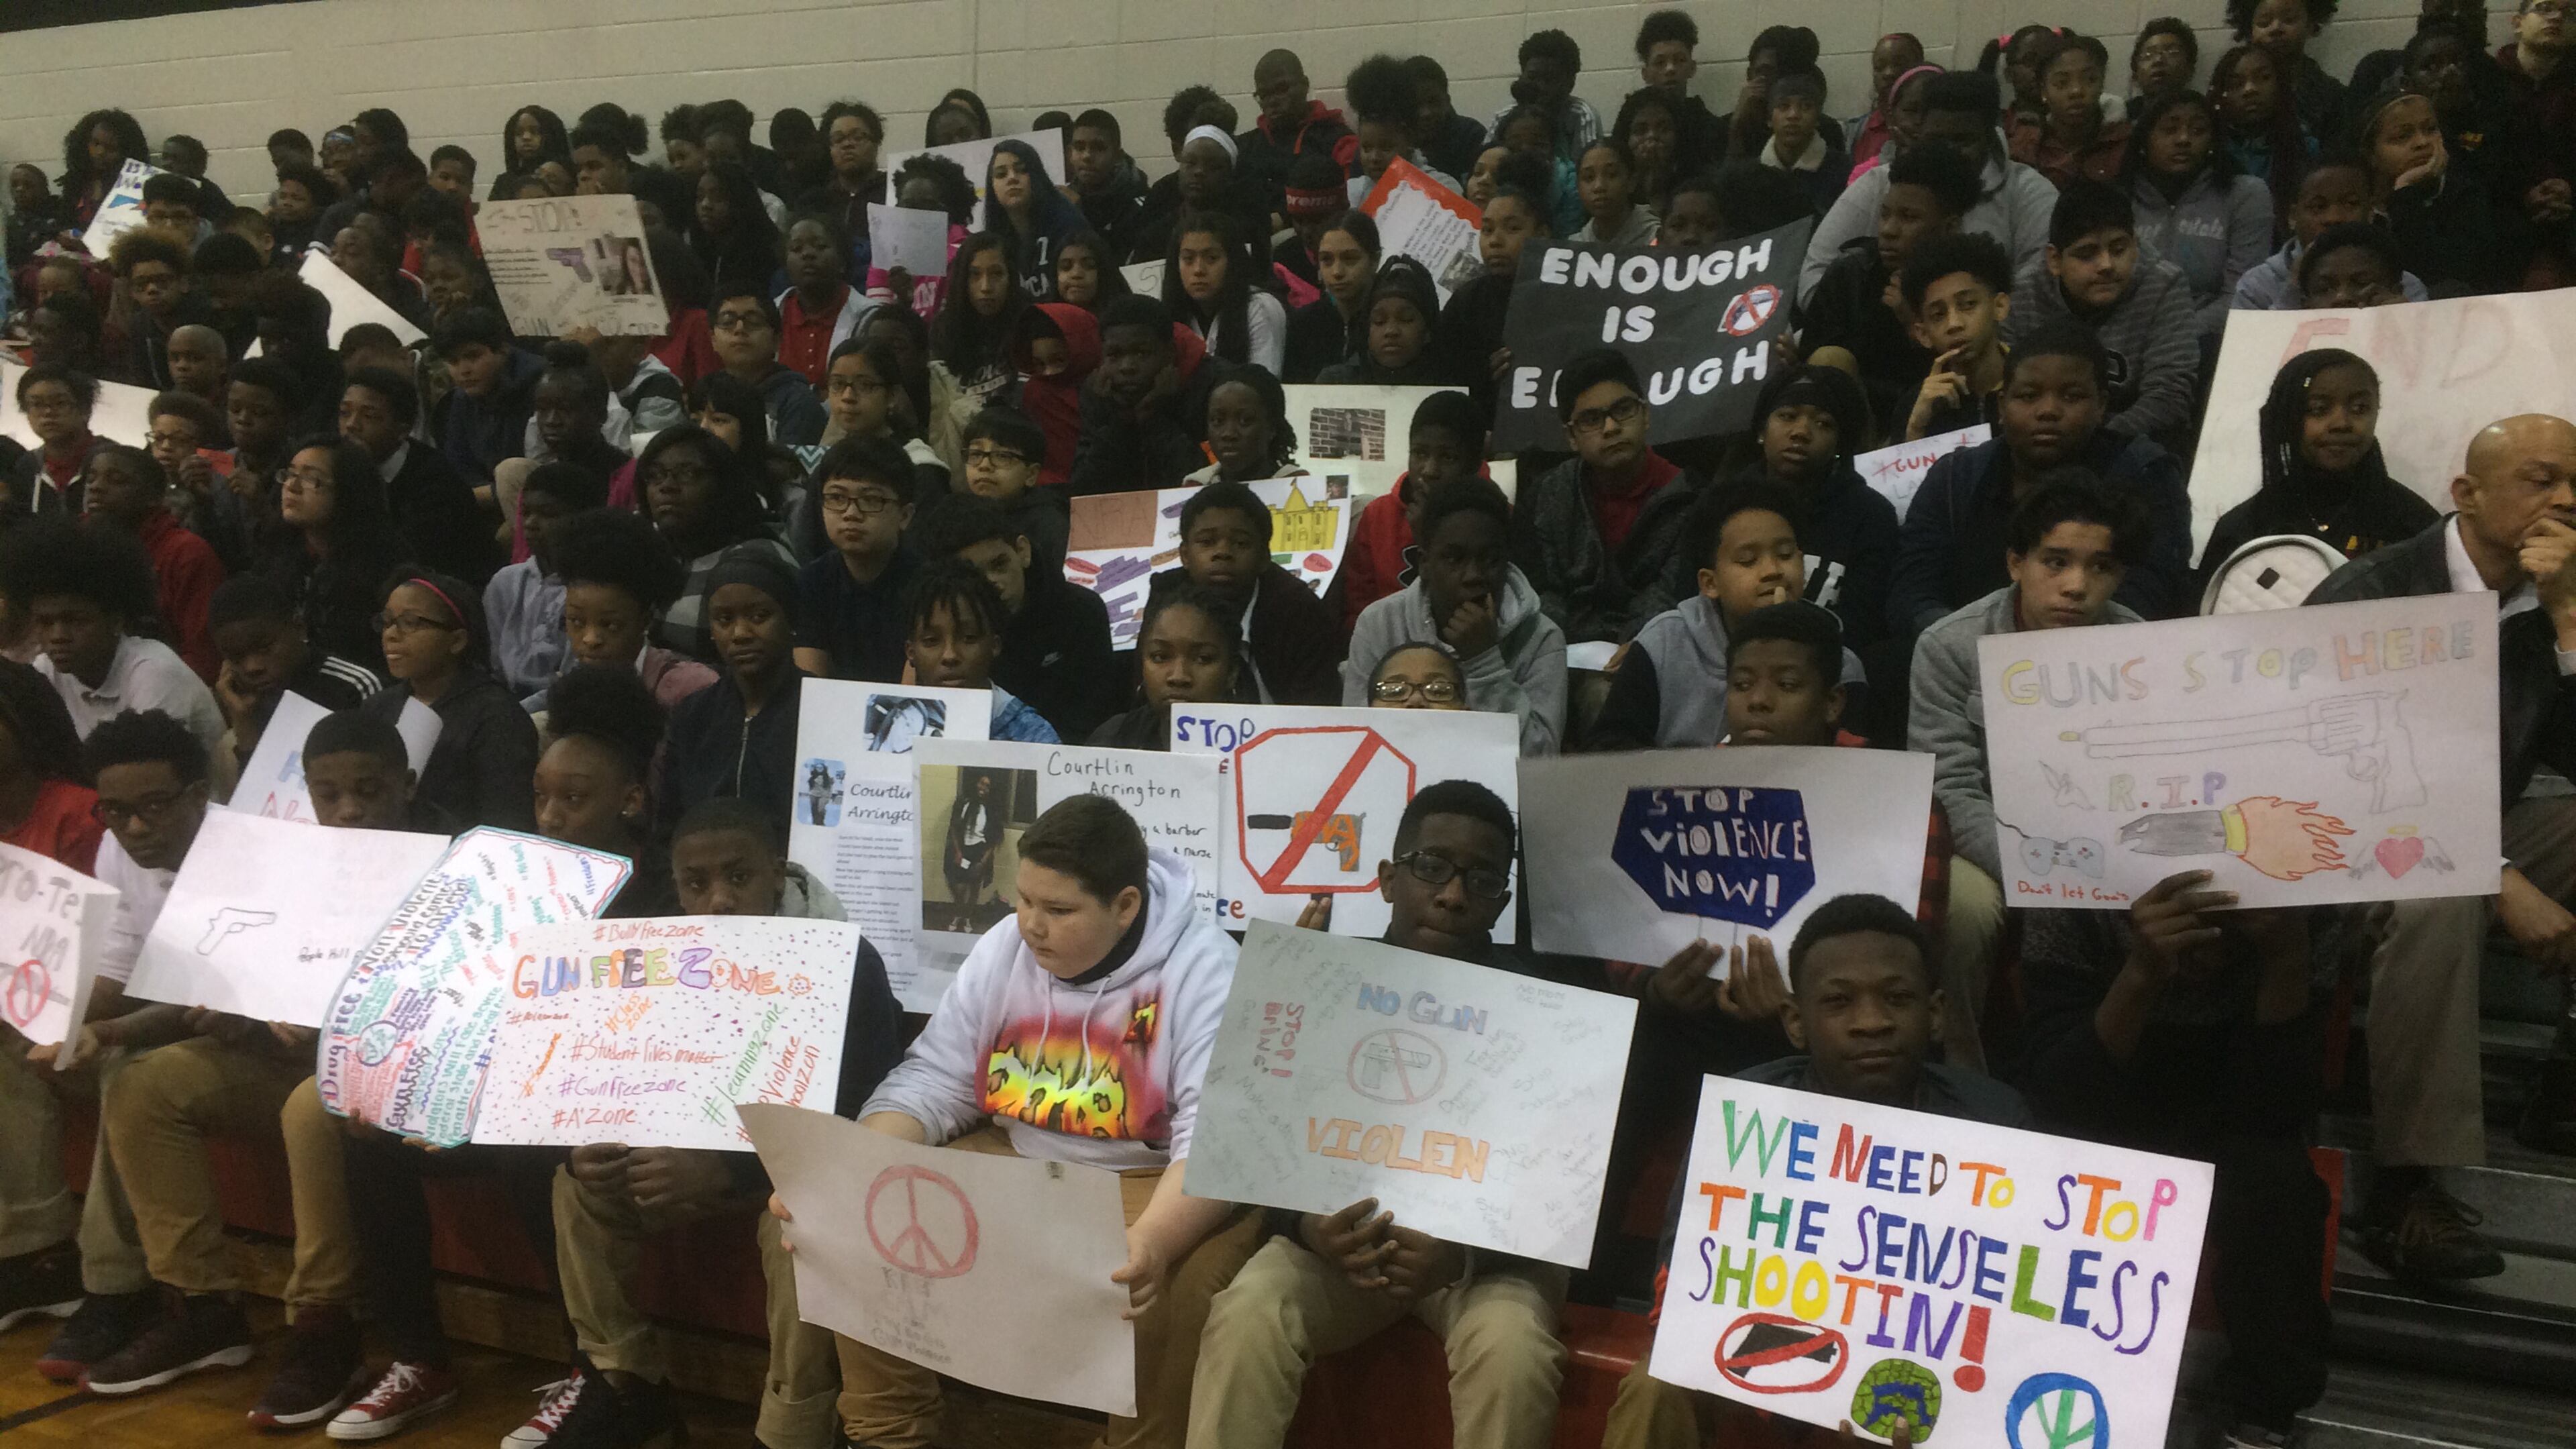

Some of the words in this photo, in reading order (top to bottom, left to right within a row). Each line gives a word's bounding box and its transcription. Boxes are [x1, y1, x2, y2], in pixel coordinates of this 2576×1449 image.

[1540, 238, 1773, 294] ENOUGH
[1601, 305, 1656, 343] IS
[1511, 339, 1769, 409] EUGH
[2001, 657, 2147, 708] GUNS
[2182, 647, 2319, 694] STOP
[2334, 620, 2475, 682] HERE
[1177, 715, 1255, 753] STOP
[1047, 751, 1134, 775] Courtlin
[1089, 780, 1181, 806] Arrington
[1647, 788, 1755, 816] STOP
[1662, 861, 1780, 918] NOW!
[512, 953, 581, 999] GUN
[678, 947, 781, 998] ZONE
[321, 1044, 347, 1103] Drug
[1305, 1116, 1490, 1184] VIOLEN
[1721, 1099, 1820, 1183] WE
[1829, 1123, 1949, 1197] NEED
[2043, 1174, 2178, 1243] STOP
[1699, 1182, 1831, 1254] THE
[1838, 1205, 2171, 1356] SENSELESS
[1688, 1236, 1992, 1394] SHOOTIN!
